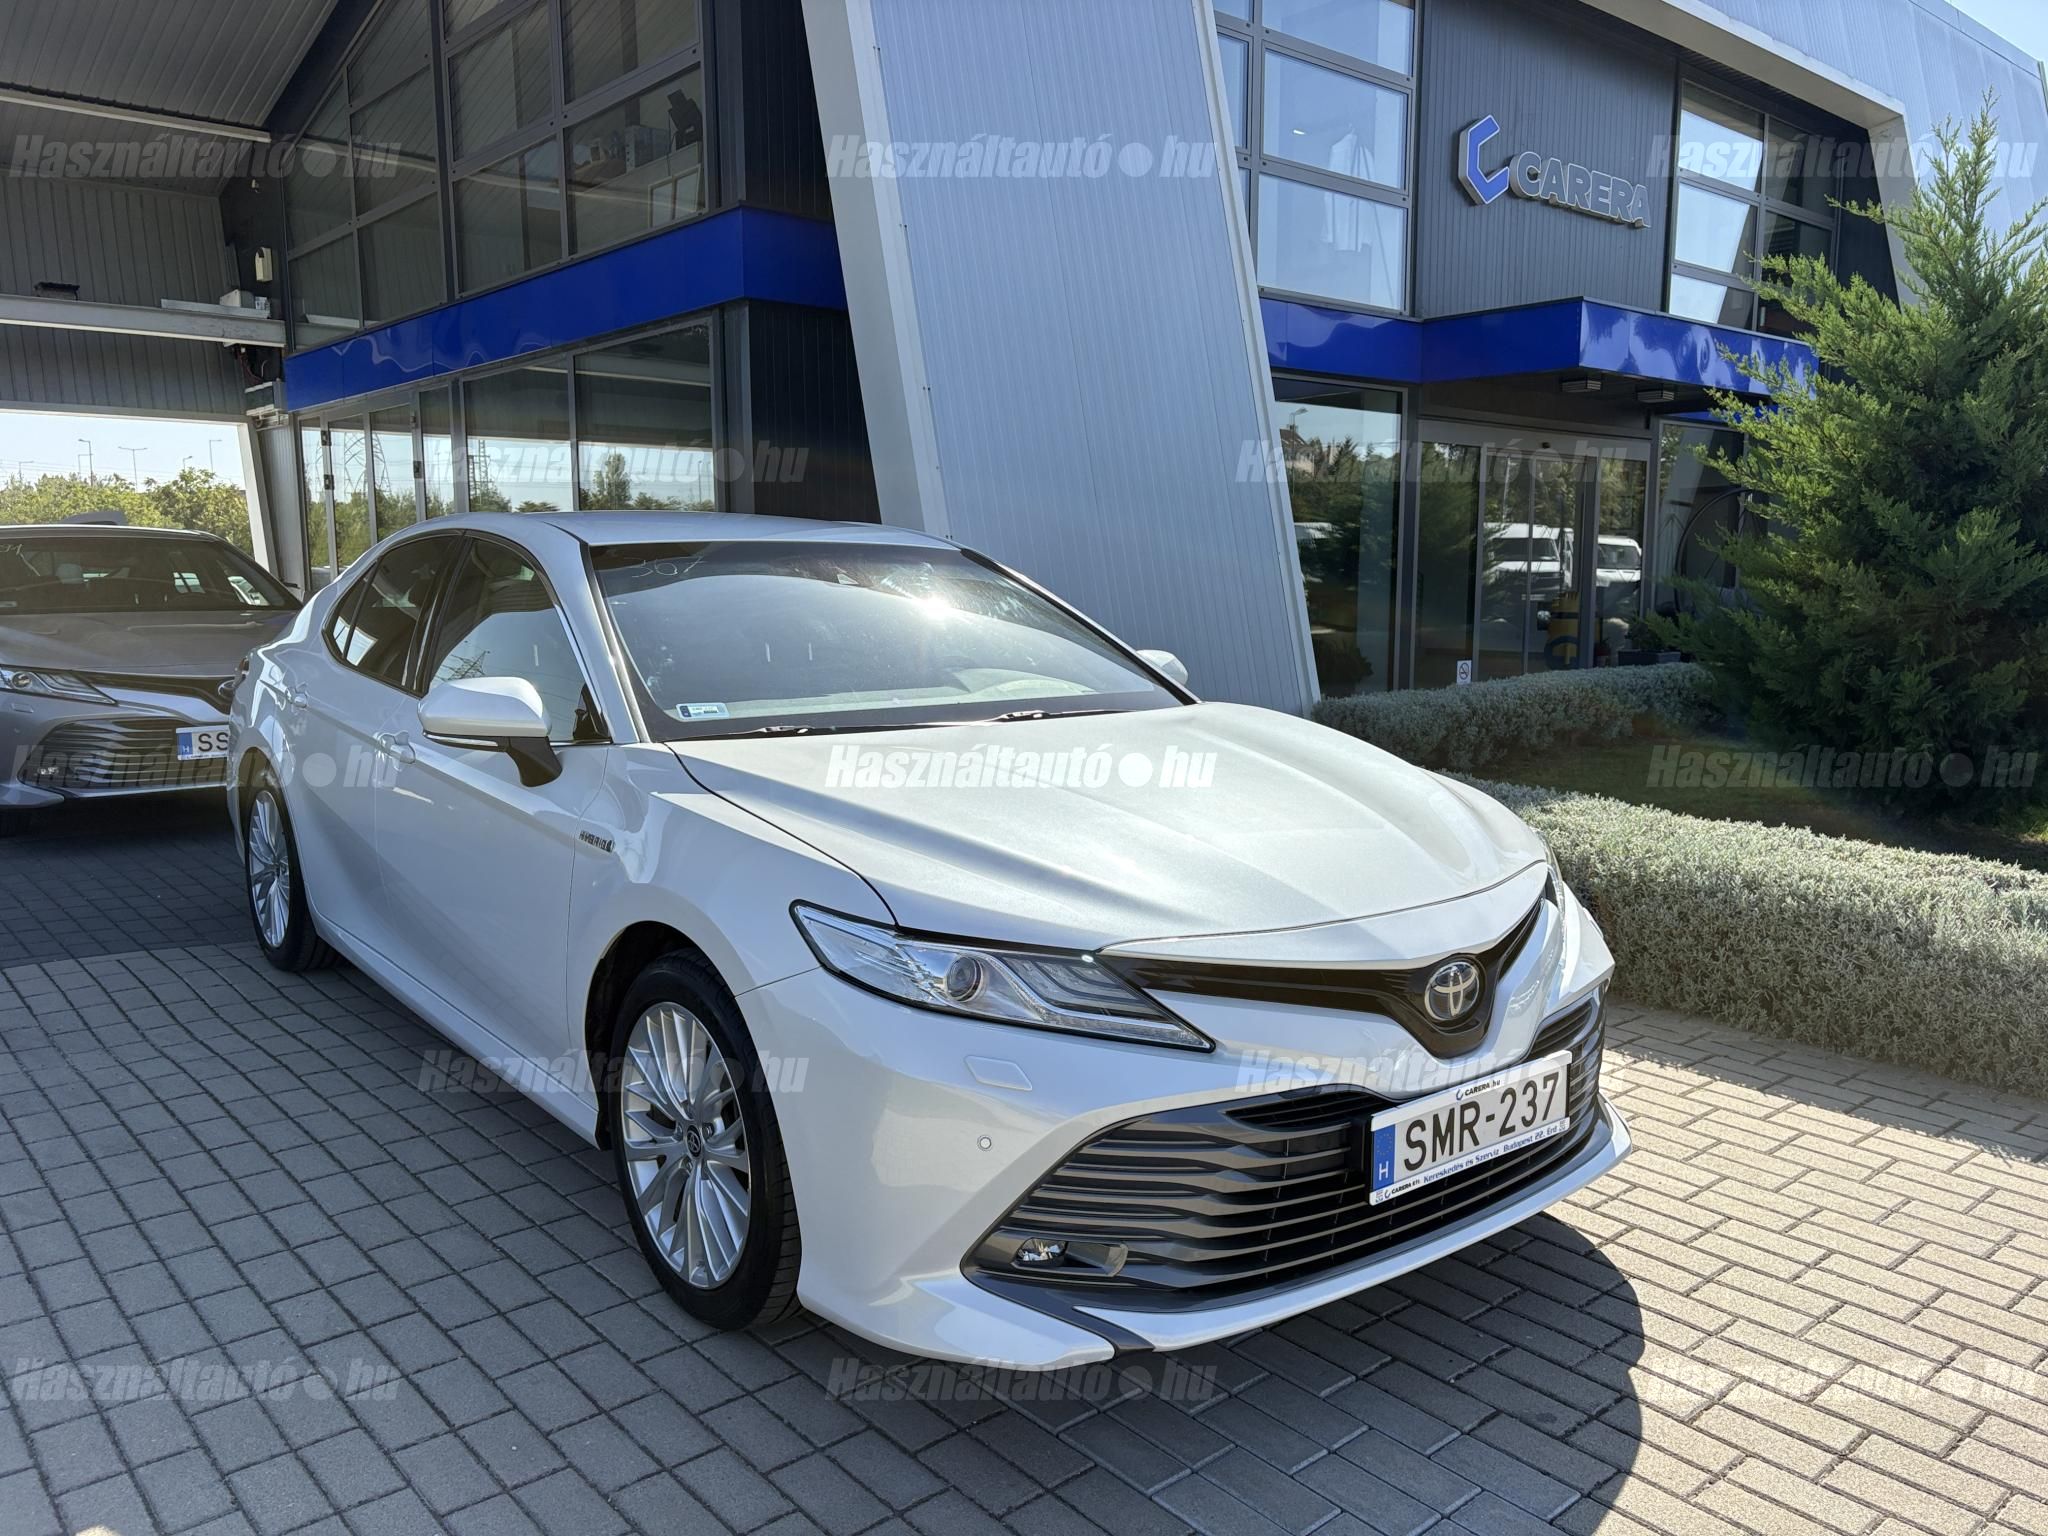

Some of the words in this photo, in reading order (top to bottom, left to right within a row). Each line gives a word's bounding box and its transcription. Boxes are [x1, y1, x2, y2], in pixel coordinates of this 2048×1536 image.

[1514, 151, 1650, 228] CARERA
[1404, 1071, 1560, 1171] SMR-237
[1378, 1161, 1389, 1181] H
